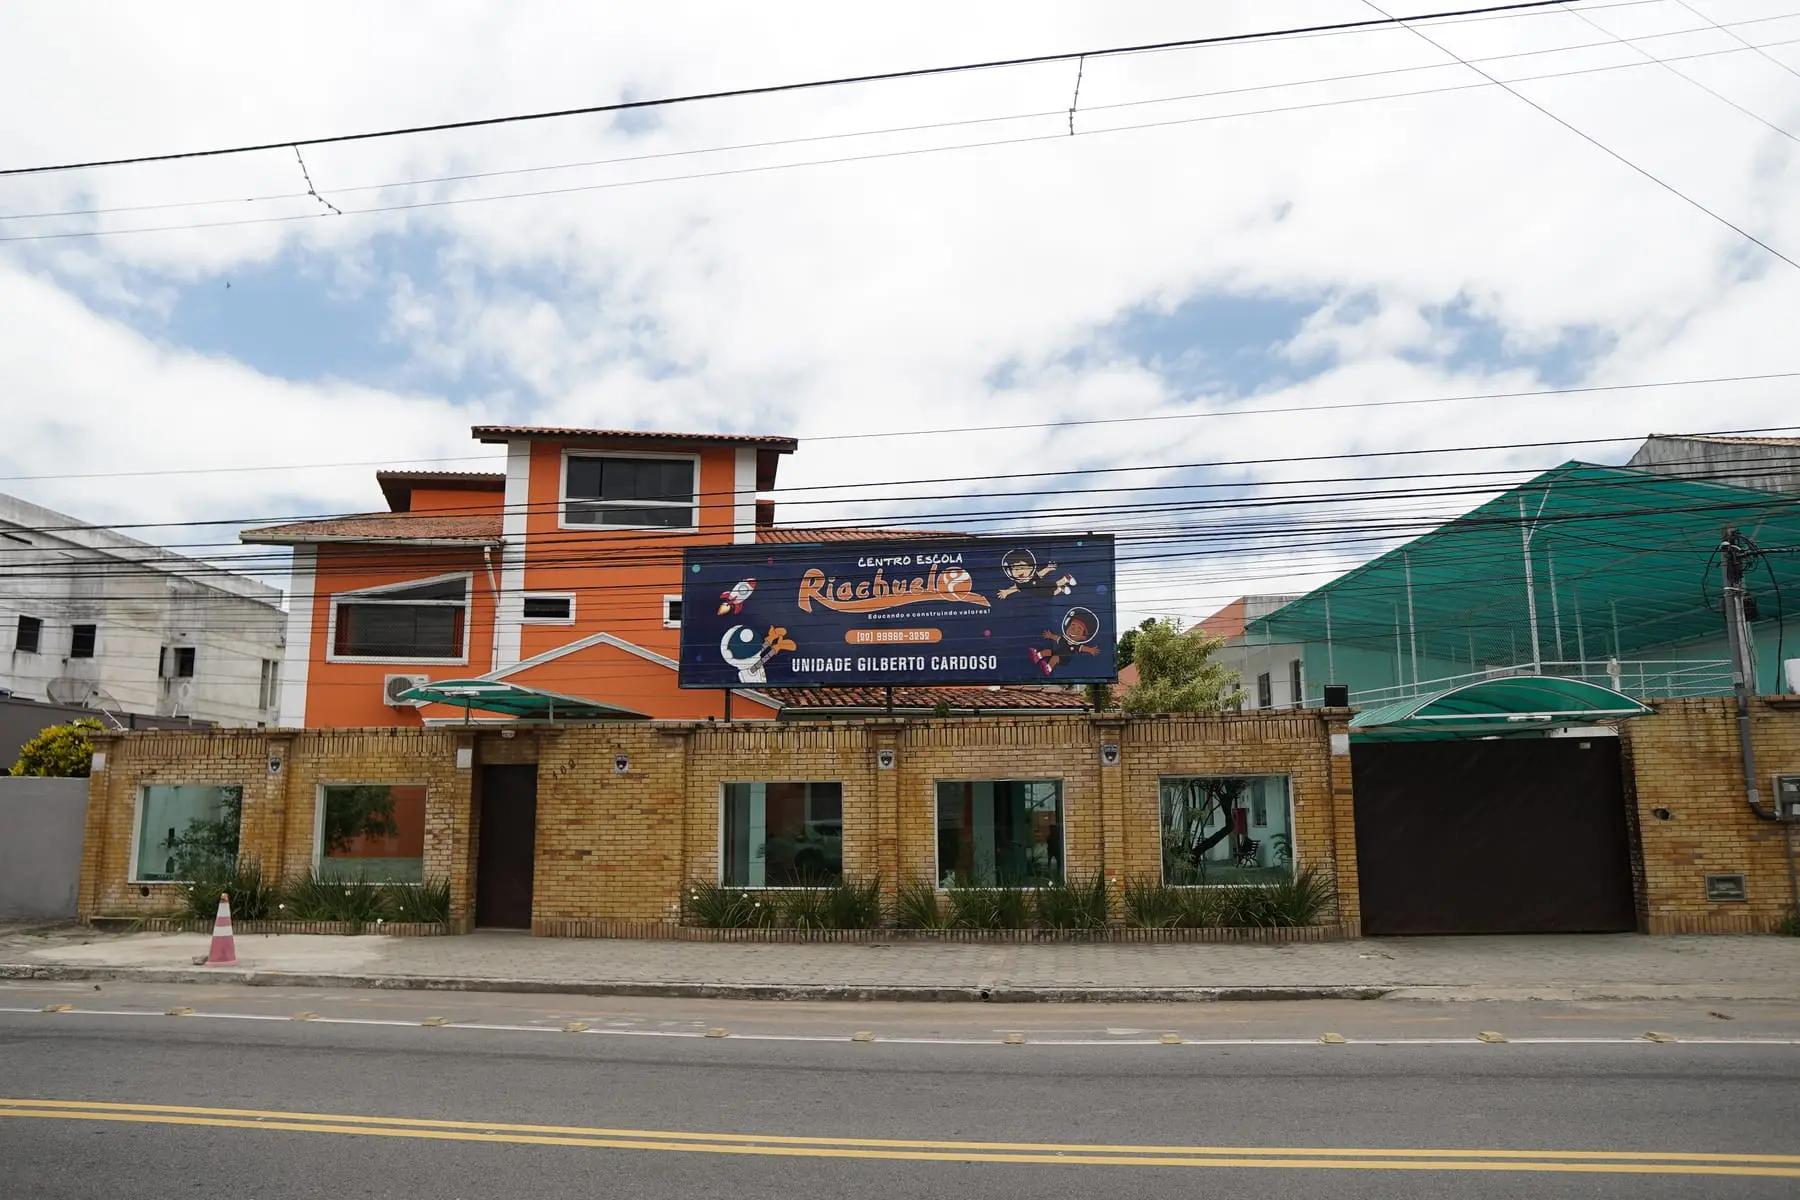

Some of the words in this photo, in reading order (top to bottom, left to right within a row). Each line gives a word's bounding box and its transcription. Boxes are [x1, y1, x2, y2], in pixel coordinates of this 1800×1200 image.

[857, 557, 911, 568] CENTRO
[916, 553, 963, 565] ESCOLA
[911, 610, 958, 618] construindo
[791, 658, 852, 673] UNIDADE
[857, 656, 925, 672] GILBERTO
[931, 655, 997, 671] CARDOSO
